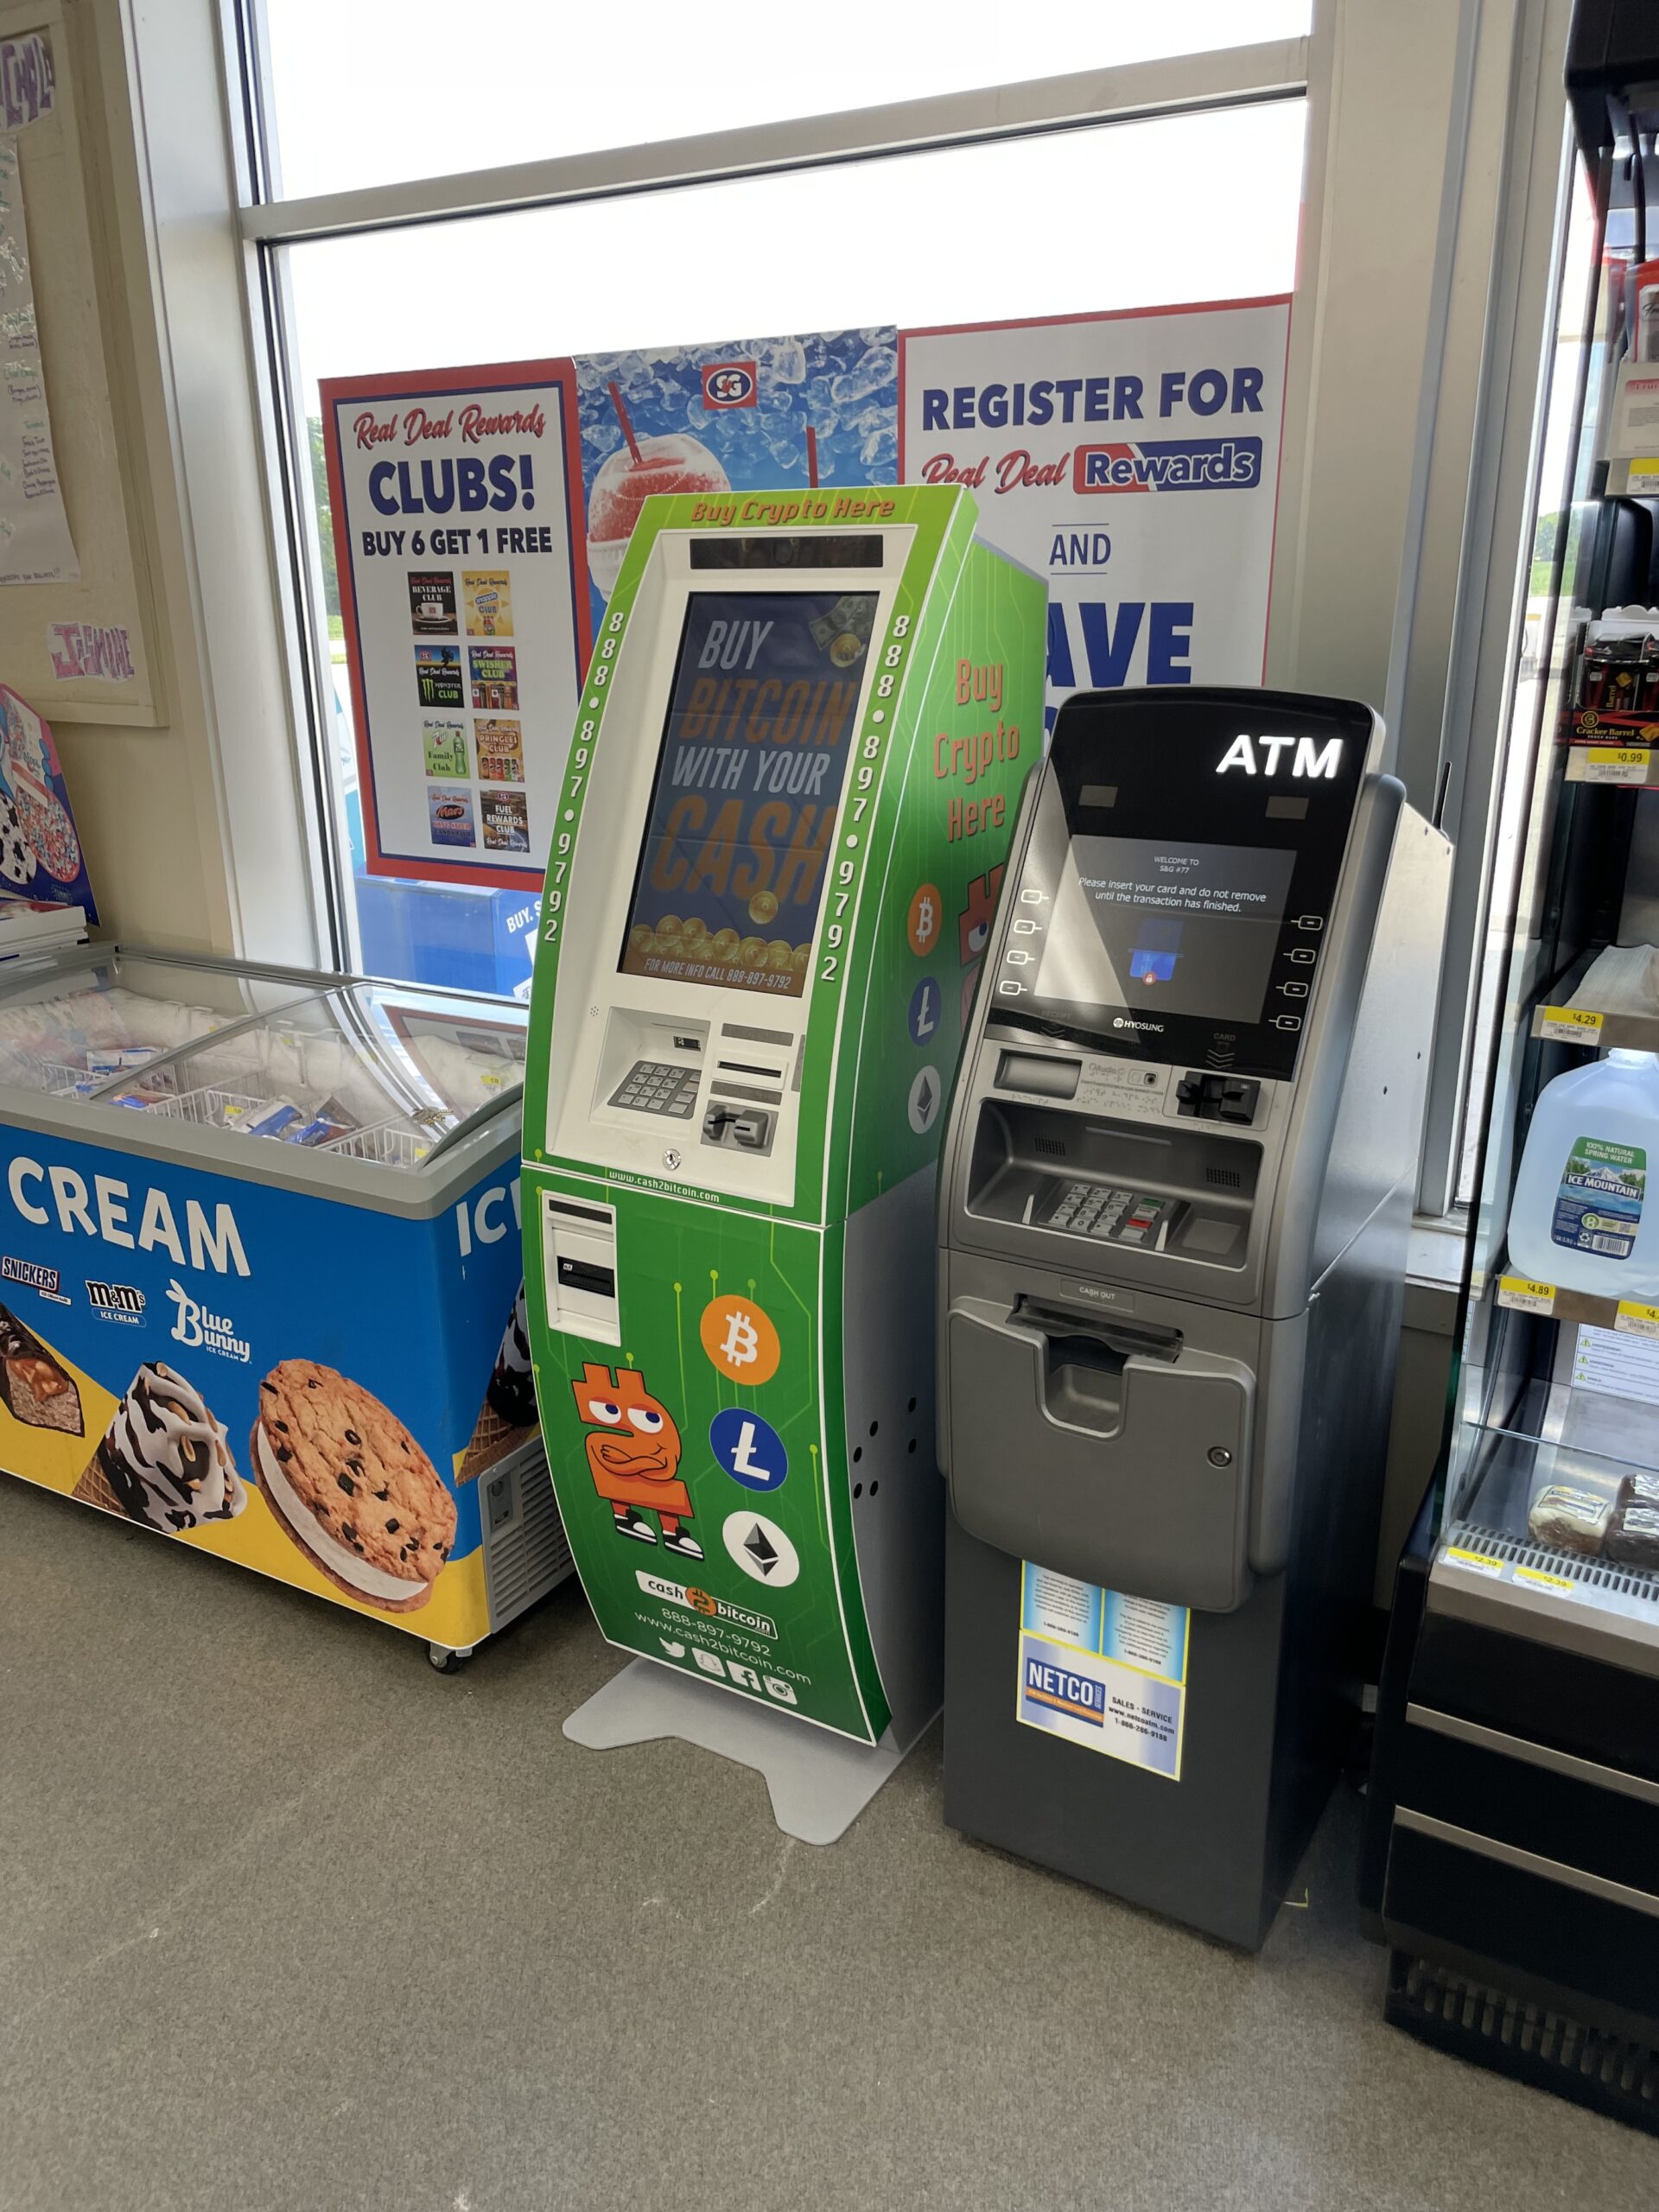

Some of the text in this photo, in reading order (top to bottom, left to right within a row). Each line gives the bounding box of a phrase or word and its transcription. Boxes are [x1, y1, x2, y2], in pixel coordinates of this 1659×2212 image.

[922, 367, 1264, 430] REGISTER FOR
[353, 404, 546, 450] Real Deal Rewards
[921, 443, 1255, 494] Real Deal Rewards
[369, 454, 535, 516] CLUBS!
[691, 497, 895, 525] Buy Crypto Here
[362, 527, 553, 556] BUY 6 GET 1 FREE
[1049, 533, 1111, 566] AND
[698, 620, 774, 670] BUY
[1046, 601, 1194, 688] AVE
[481, 670, 505, 678] CLUB
[956, 658, 1003, 712] Buy
[438, 690, 459, 699] CLUB
[679, 677, 857, 747] BITCOIN
[1609, 728, 1635, 737] Barrel
[489, 744, 510, 753] CLUB
[933, 720, 1020, 784] Crypto
[1215, 734, 1344, 779] ATM
[1618, 752, 1643, 763] $0.99
[671, 746, 831, 797] WITH YOUR
[486, 814, 523, 824] REWARDS
[495, 804, 512, 814] FUEL
[948, 793, 1006, 842] Here
[496, 824, 515, 834] CLUB
[651, 794, 838, 906] CASH
[1154, 856, 1188, 866] WELCOME
[1078, 877, 1267, 903] Please insert your card and do not remove
[1095, 891, 1242, 913] until the transaction has finished.
[506, 906, 534, 933] BUY.
[644, 957, 791, 989] FOR MORE INFO CALL 888-897-9792
[1124, 1020, 1164, 1033] HYOSUNG
[1573, 1013, 1597, 1026] $4.29
[1585, 1148, 1633, 1165] SPRING WATER
[1605, 1145, 1635, 1158] NATURAL
[609, 1170, 720, 1204] www.cash2bitcoin.com
[1567, 1175, 1638, 1198] ICE MOUNTAIN
[9, 1156, 251, 1276] CREAM
[4, 1257, 56, 1289] SNICKERS
[1079, 1286, 1116, 1300] CASH OUT
[1527, 1282, 1549, 1295] $4.89
[100, 1311, 139, 1325] ICE CREAM
[1646, 1308, 1659, 1320] $4.
[217, 1348, 239, 1361] CREAM
[648, 1579, 683, 1599] cash
[717, 1602, 771, 1632] bitcoin
[662, 1607, 772, 1657] 888-897-9792
[634, 1611, 812, 1685] www.cash2bitcoin.com
[1029, 1662, 1093, 1706] NETCO
[1109, 1706, 1175, 1735] www.netcoatm.com
[1112, 1696, 1135, 1710] SALES
[1141, 1707, 1173, 1724] SERVICE
